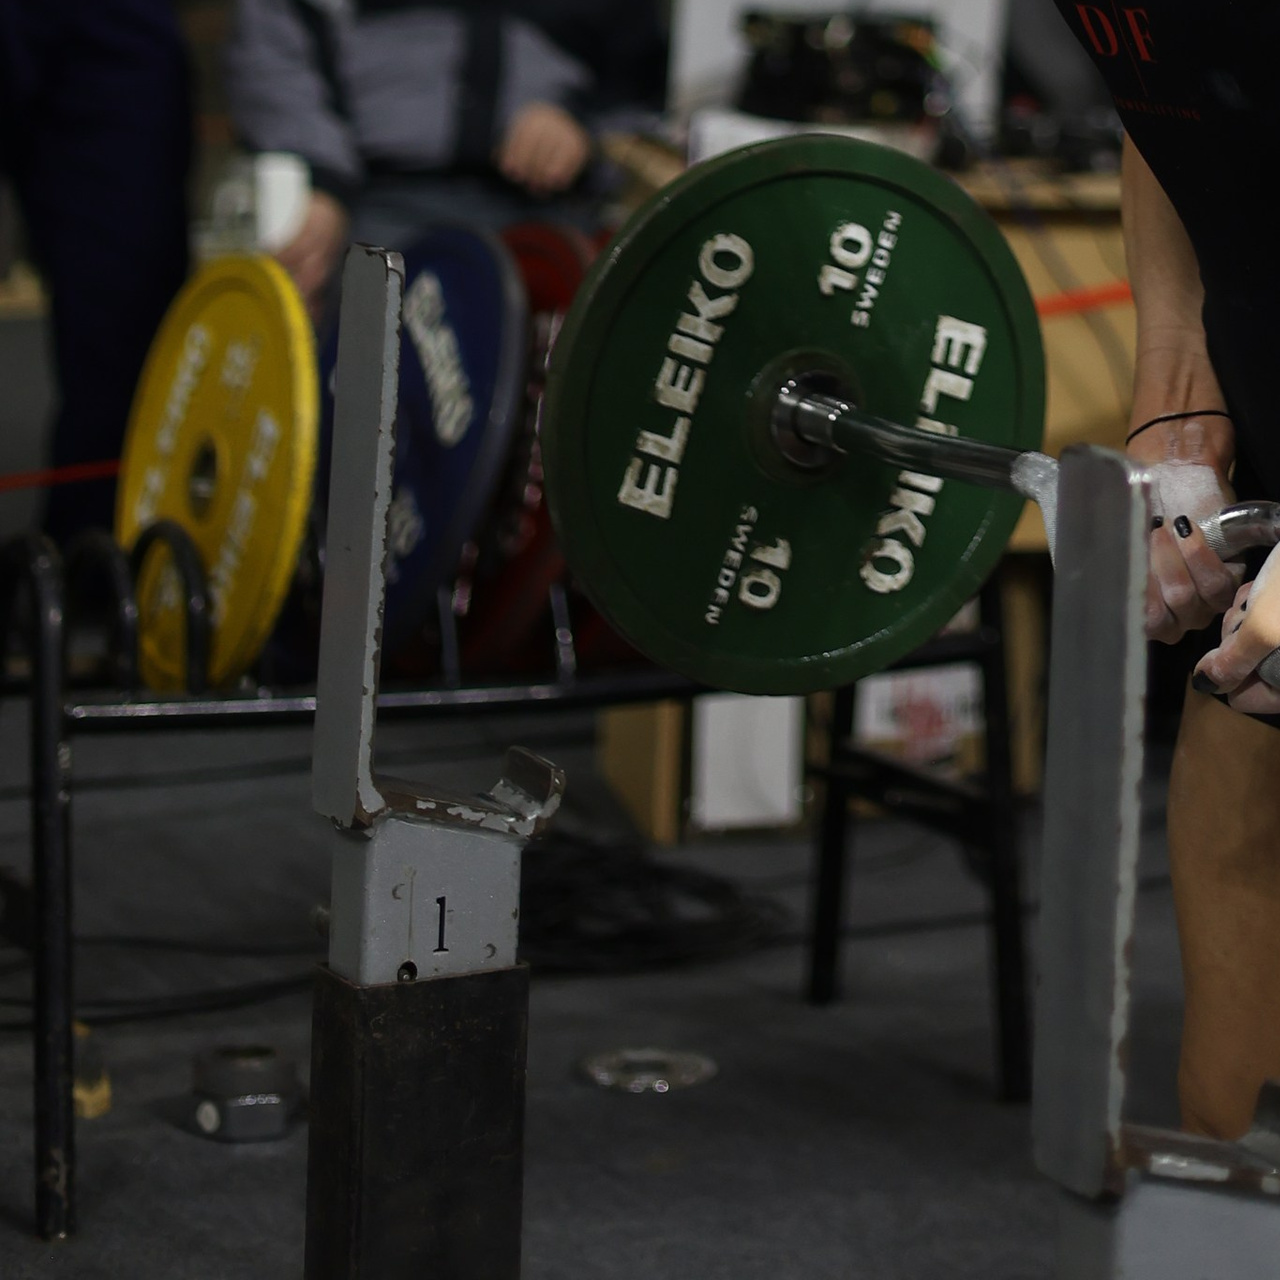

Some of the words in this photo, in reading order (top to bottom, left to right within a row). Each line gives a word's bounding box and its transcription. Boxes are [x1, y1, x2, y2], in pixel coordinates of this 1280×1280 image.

[817, 219, 873, 297] 10
[851, 210, 902, 328] SWEDEN
[616, 231, 754, 520] ELEIKO
[704, 505, 760, 625] SWEDEN
[738, 537, 793, 611] 10
[433, 896, 449, 952] 1
